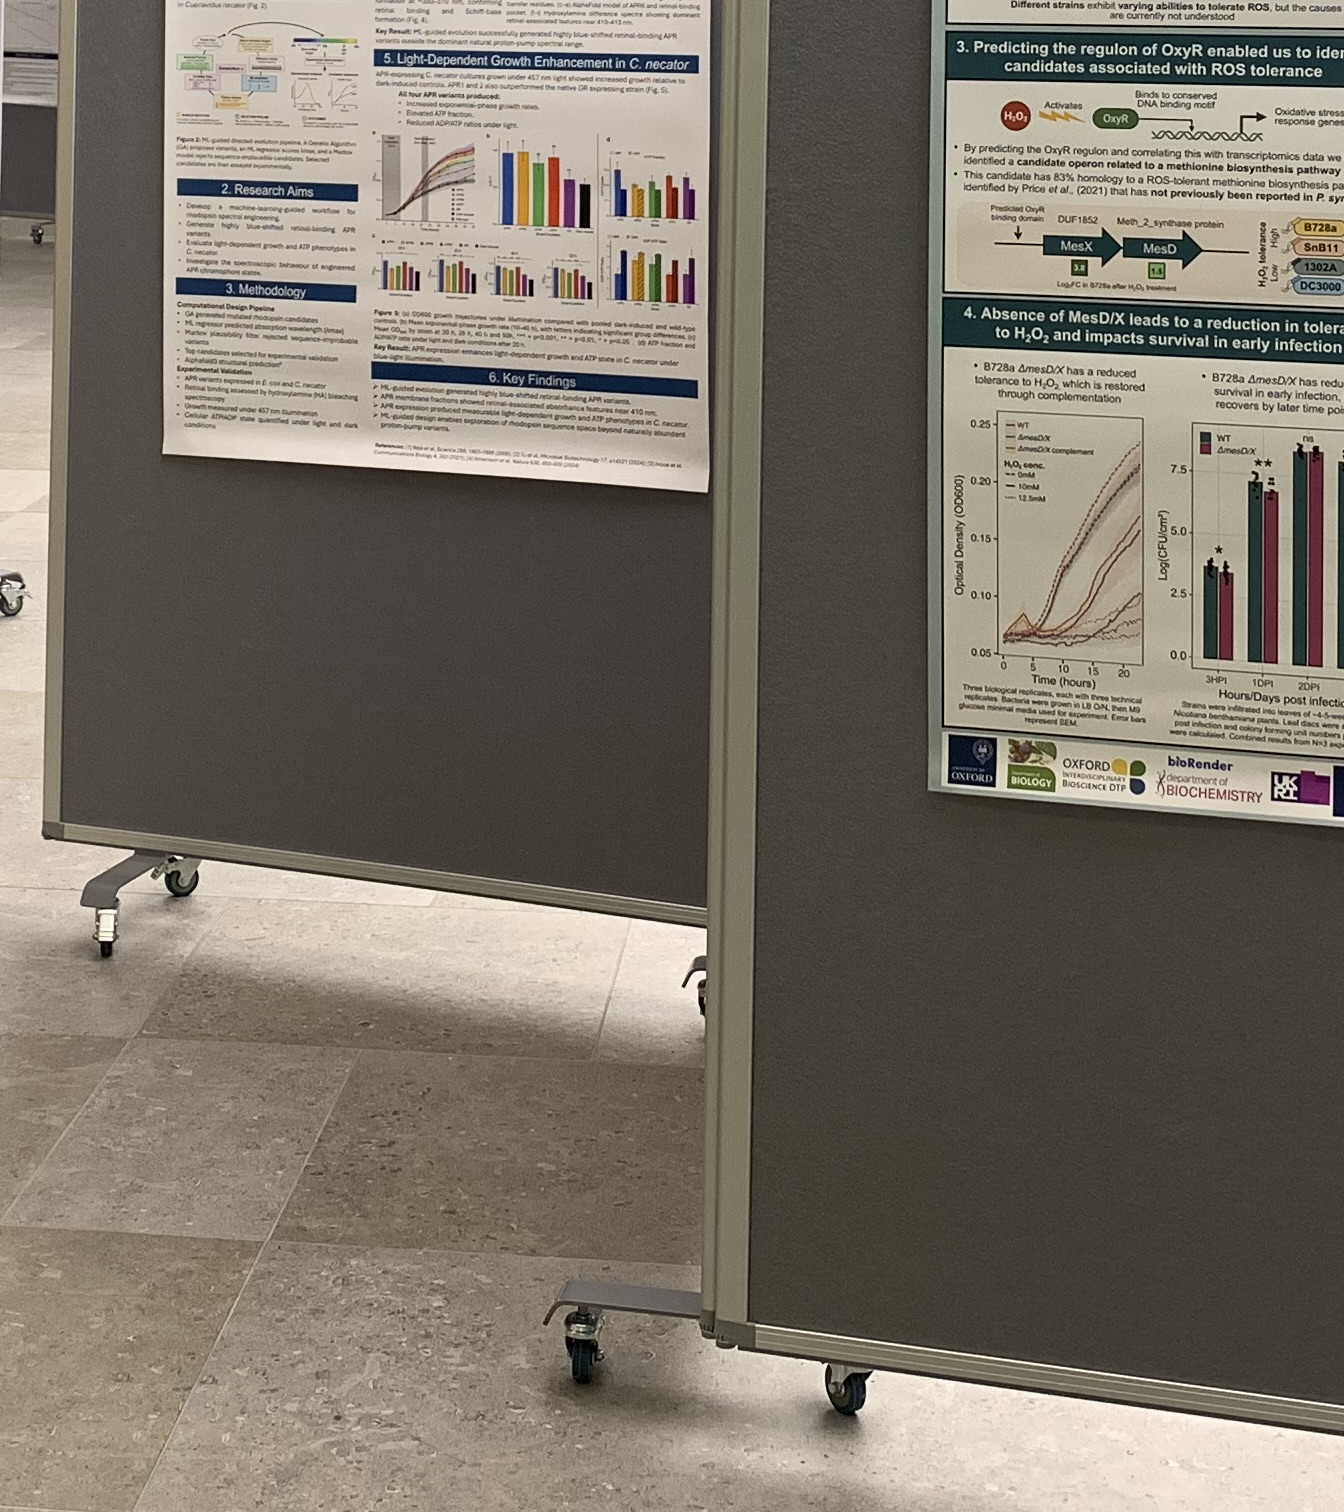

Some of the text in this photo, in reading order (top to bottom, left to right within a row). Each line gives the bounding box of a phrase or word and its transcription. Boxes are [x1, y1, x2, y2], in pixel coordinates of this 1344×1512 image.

[956, 40, 969, 52] 3.
[974, 40, 1048, 57] Predicting
[1052, 42, 1076, 54] the
[1080, 42, 1137, 58] regulon
[1142, 43, 1157, 56] of
[1161, 43, 1203, 59] OxyR
[1207, 44, 1267, 57] enabled
[1273, 48, 1291, 58] us
[1295, 46, 1311, 58] to
[383, 52, 690, 70] 5. Light-Dependent Growth Enhancement in C. necator
[1004, 59, 1322, 77] candidates associated with ROS tolerance
[221, 183, 314, 197] 2. Research Aims
[1304, 223, 1338, 233] B728a
[1304, 243, 1339, 252] SnB11
[1304, 262, 1338, 272] 1302A
[225, 282, 306, 299] 3. Methodology
[1300, 281, 1342, 291] DC3000
[488, 371, 576, 389] 6. Key Findings
[1063, 758, 1111, 772] OXFORD
[1168, 756, 1233, 772] bioRender
[951, 771, 994, 783] OXFORD
[1011, 777, 1052, 788] BIOLOGY
[1166, 786, 1263, 804] BIOCHEMISTRY
